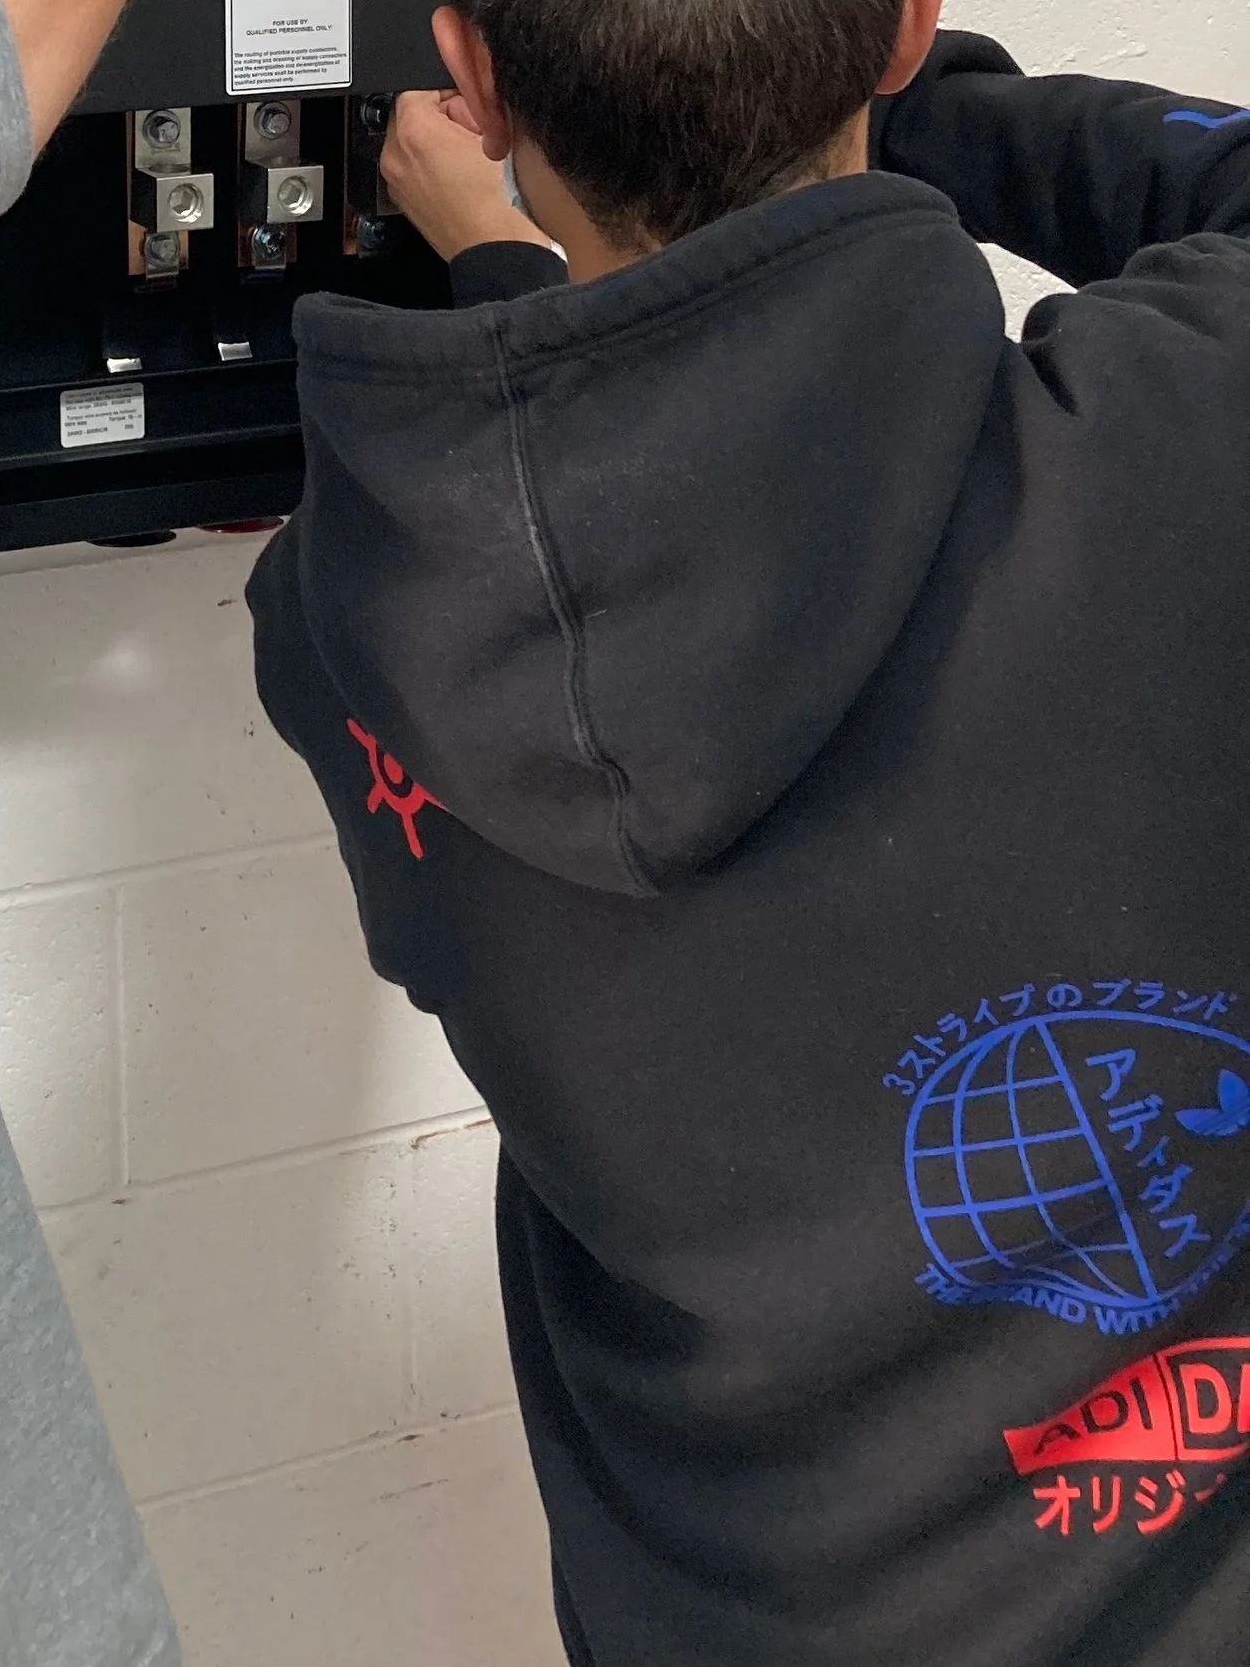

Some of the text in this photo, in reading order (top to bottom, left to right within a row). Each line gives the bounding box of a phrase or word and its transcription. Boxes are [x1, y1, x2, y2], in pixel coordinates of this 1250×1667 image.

[246, 28, 277, 36] QUALIFIED
[278, 25, 314, 34] PERSONNEL
[1085, 1047, 1211, 1259] アディダス
